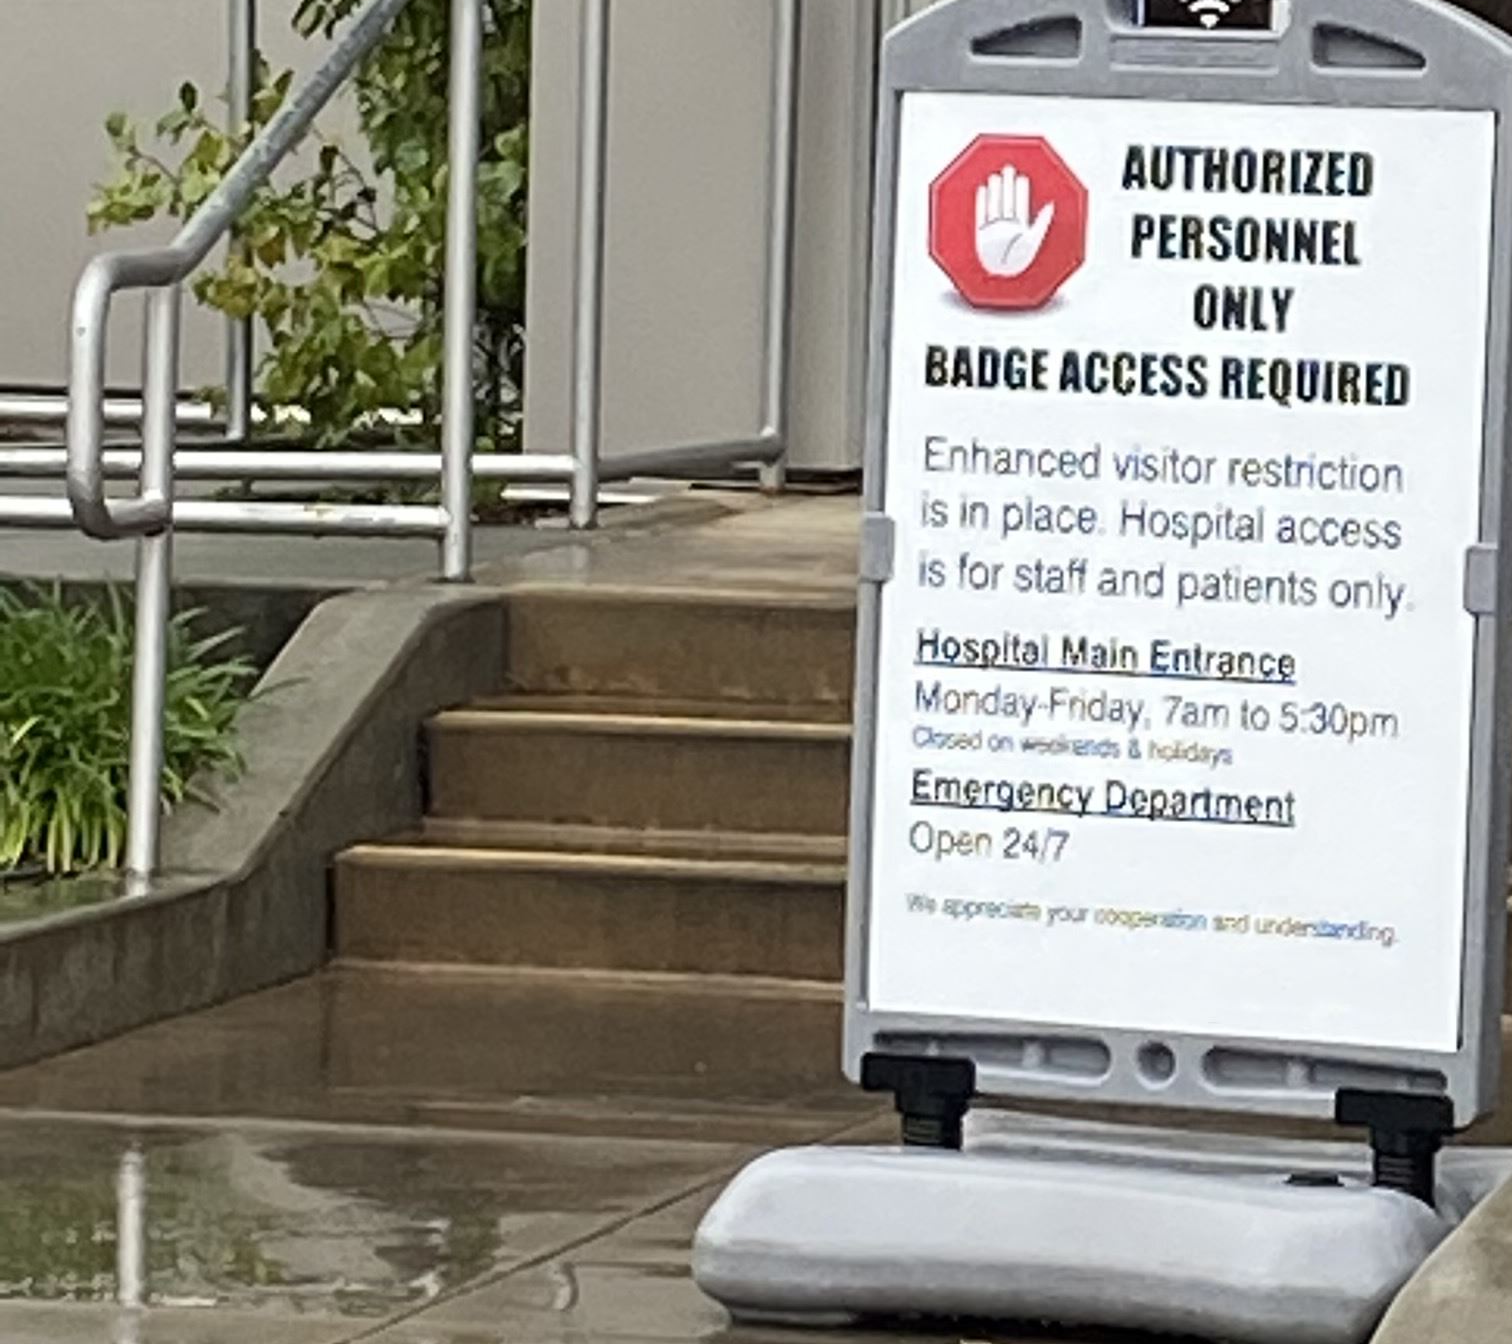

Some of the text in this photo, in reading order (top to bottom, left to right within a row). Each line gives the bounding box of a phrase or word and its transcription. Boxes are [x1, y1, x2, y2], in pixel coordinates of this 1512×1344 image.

[1122, 145, 1373, 196] AUTHORIZED
[1131, 214, 1360, 265] PERSONNEL
[1194, 284, 1294, 333] ONLY
[925, 345, 1409, 407] BADGE ACCESS REQUIRED
[925, 436, 1402, 493] Enhanced visitor restriction
[922, 493, 1401, 550] is in place. Hospital access
[919, 555, 1414, 619] is for staff and patients only.
[916, 629, 1296, 679] Hospital Main Entrance
[912, 680, 1398, 741] Monday-Friday, 7am to 5:30pm
[987, 734, 1014, 752] on
[911, 768, 1295, 826] Emergency Department
[909, 821, 1070, 861] Open 24/7
[1047, 906, 1089, 927] your
